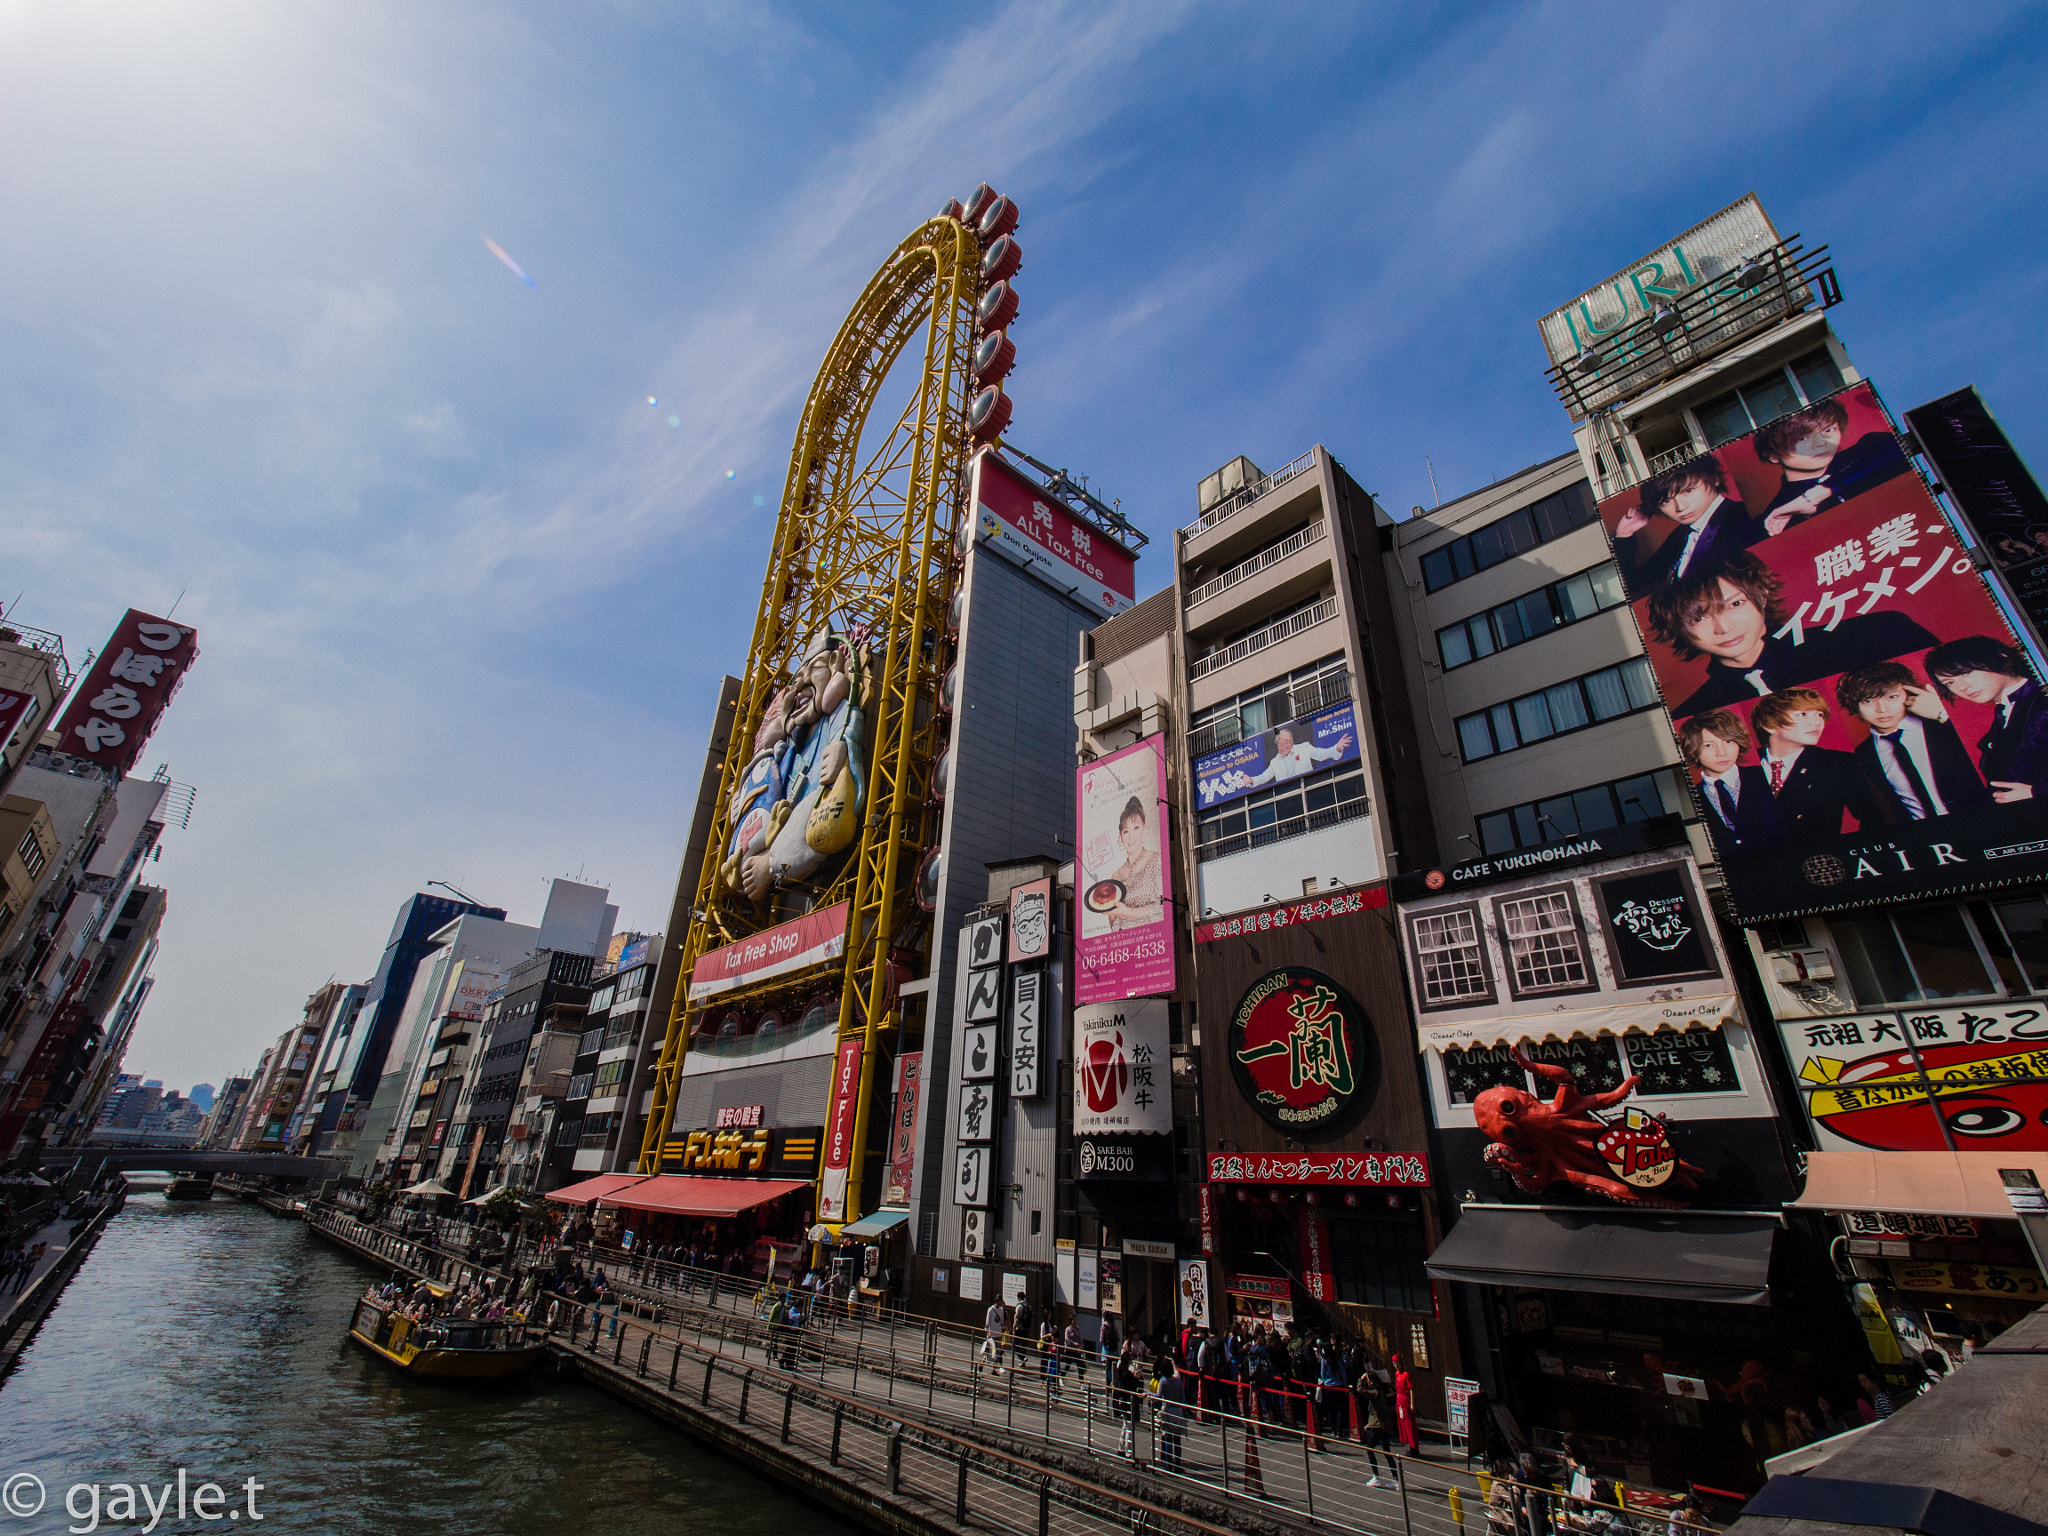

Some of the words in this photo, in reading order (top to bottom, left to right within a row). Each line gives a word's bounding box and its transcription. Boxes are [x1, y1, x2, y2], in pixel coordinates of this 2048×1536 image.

[1003, 531, 1021, 548] Don
[1022, 543, 1053, 568] Quijote
[1016, 515, 1042, 541] ALL
[1046, 533, 1072, 561] Tax
[1075, 551, 1104, 581] Free
[1771, 546, 1972, 647] イケメン。
[1317, 721, 1353, 739] Mr.Shin
[1234, 751, 1260, 766] OSAKA
[1452, 862, 1491, 882] CAFE
[1494, 839, 1603, 874] YUKINOHANA
[1848, 841, 1897, 857] CLUB
[1853, 842, 1969, 881] AIR
[1648, 895, 1685, 908] Dessert
[1650, 905, 1673, 915] Cafe
[725, 950, 742, 971] Tax
[743, 943, 769, 966] Free
[770, 931, 799, 957] Shop
[1081, 939, 1167, 970] 06-6468-4538
[1235, 972, 1289, 1028] ICHIRAN
[1014, 976, 1036, 1093] 旨くて安い
[1236, 985, 1355, 1095] 一蘭
[1529, 1041, 1586, 1062] HANA
[1625, 1032, 1712, 1053] DESSERT
[840, 1049, 854, 1095] Tax
[1131, 1043, 1155, 1112] 松阪牛
[1630, 1050, 1681, 1068] CAFE
[900, 1060, 917, 1154] とんぼり
[832, 1099, 846, 1162] Free
[1597, 1121, 1676, 1177] Tako
[1096, 1146, 1116, 1155] SAKE
[1116, 1145, 1133, 1156] BAR
[1096, 1155, 1135, 1173] M300
[1652, 1164, 1671, 1176] Bar
